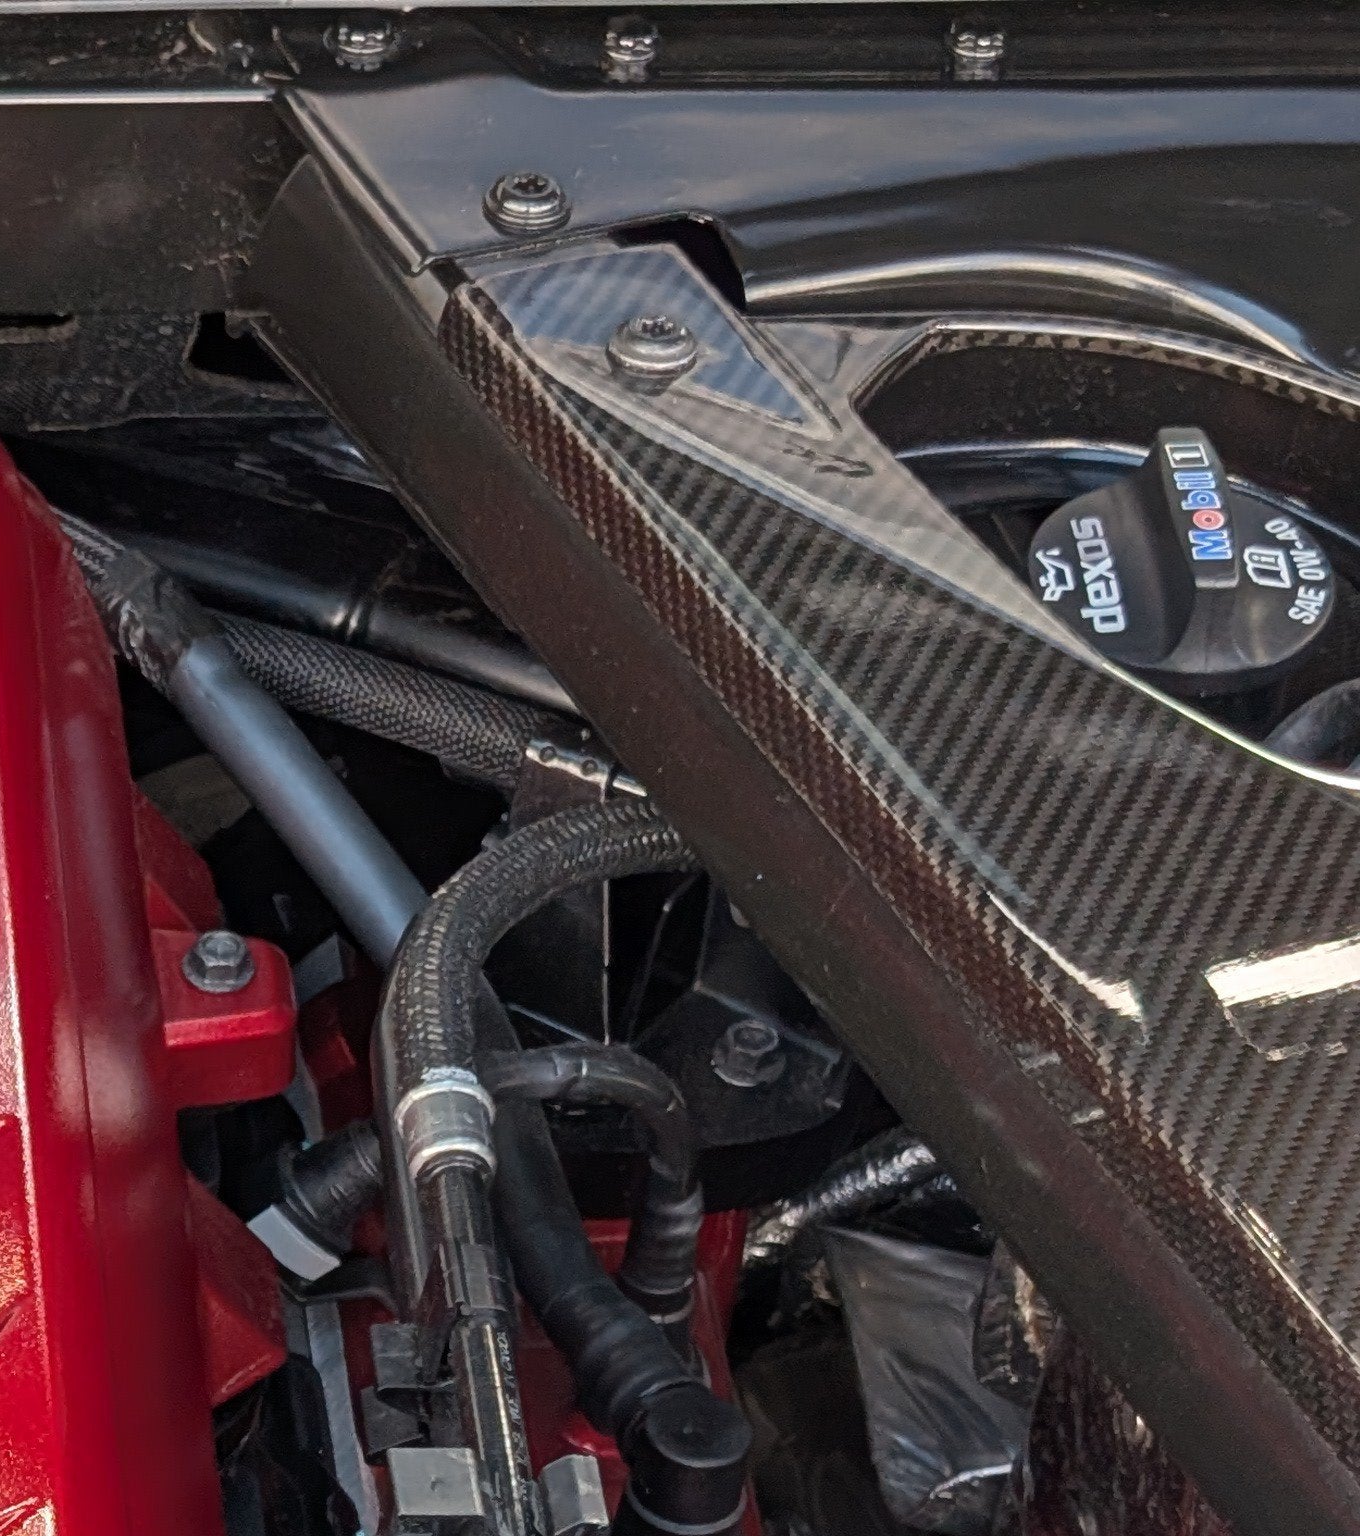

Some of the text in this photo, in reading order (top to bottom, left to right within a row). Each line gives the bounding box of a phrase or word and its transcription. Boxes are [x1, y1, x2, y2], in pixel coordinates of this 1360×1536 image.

[1173, 471, 1233, 560] Mobil
[1070, 517, 1126, 634] dexos
[1265, 518, 1326, 625] SAE 0W-40
